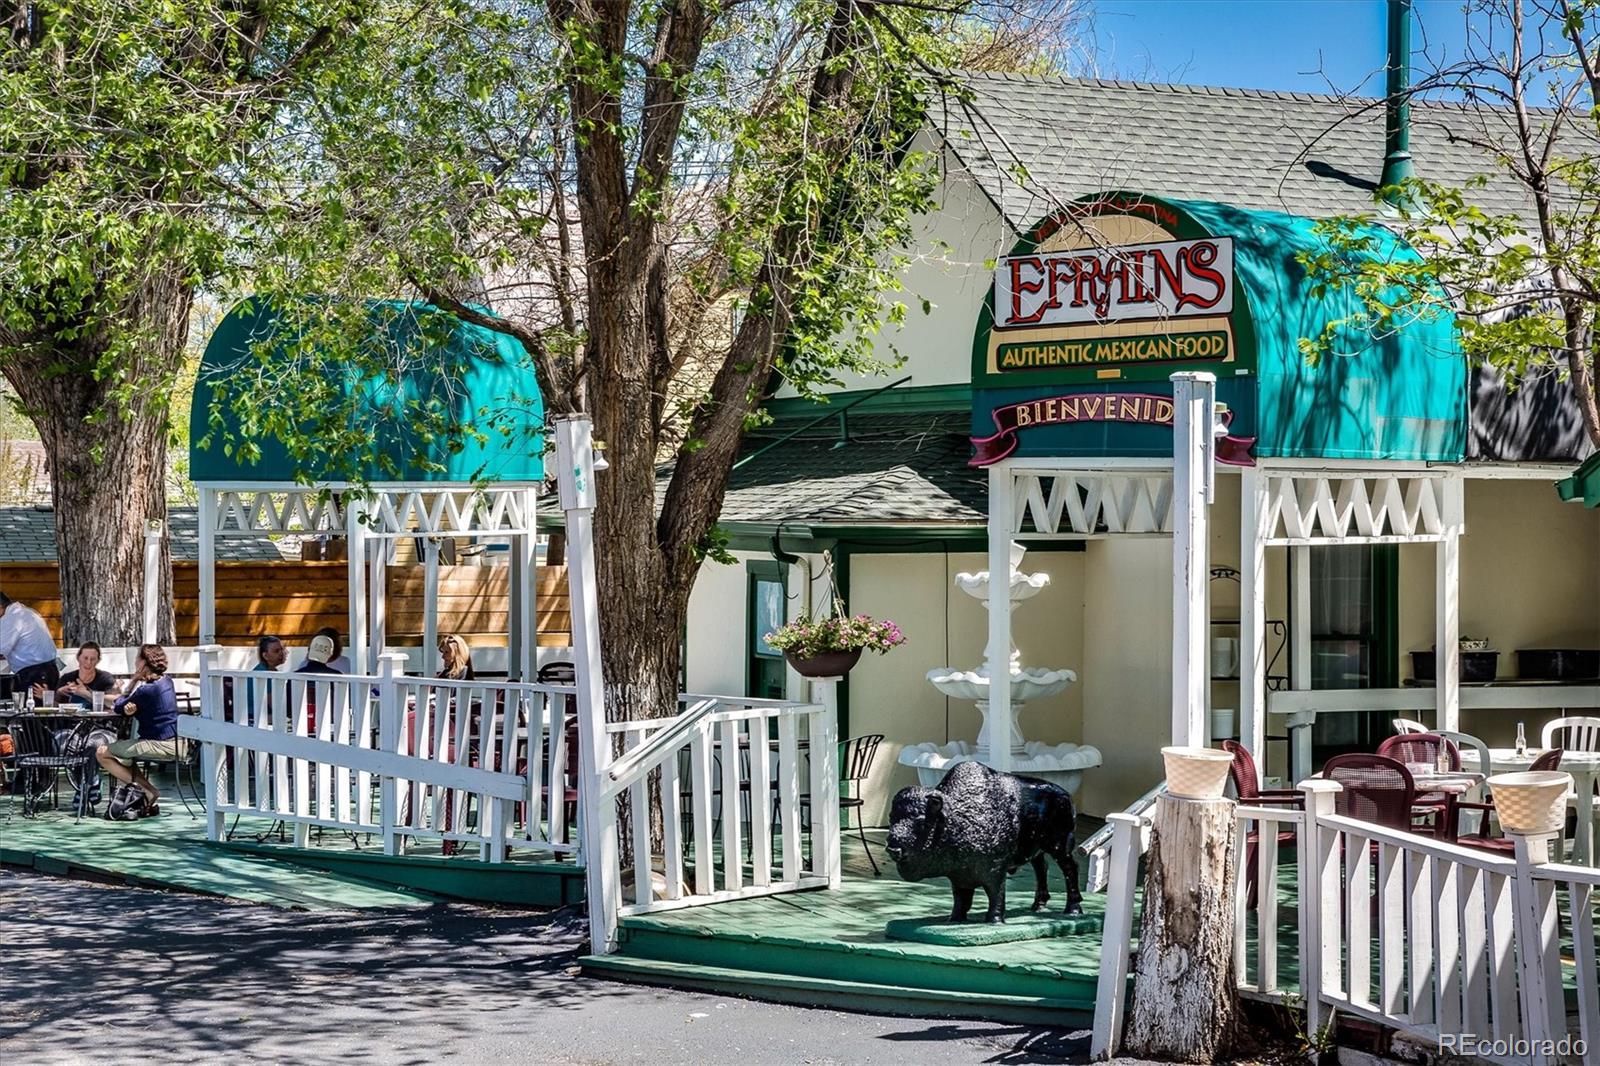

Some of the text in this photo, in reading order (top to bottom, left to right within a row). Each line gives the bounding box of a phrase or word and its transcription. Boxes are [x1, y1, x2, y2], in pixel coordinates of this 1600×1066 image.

[1002, 336, 1225, 366] AUTHENTIC MEXICAN FOOD
[1016, 396, 1174, 427] BIENVENID
